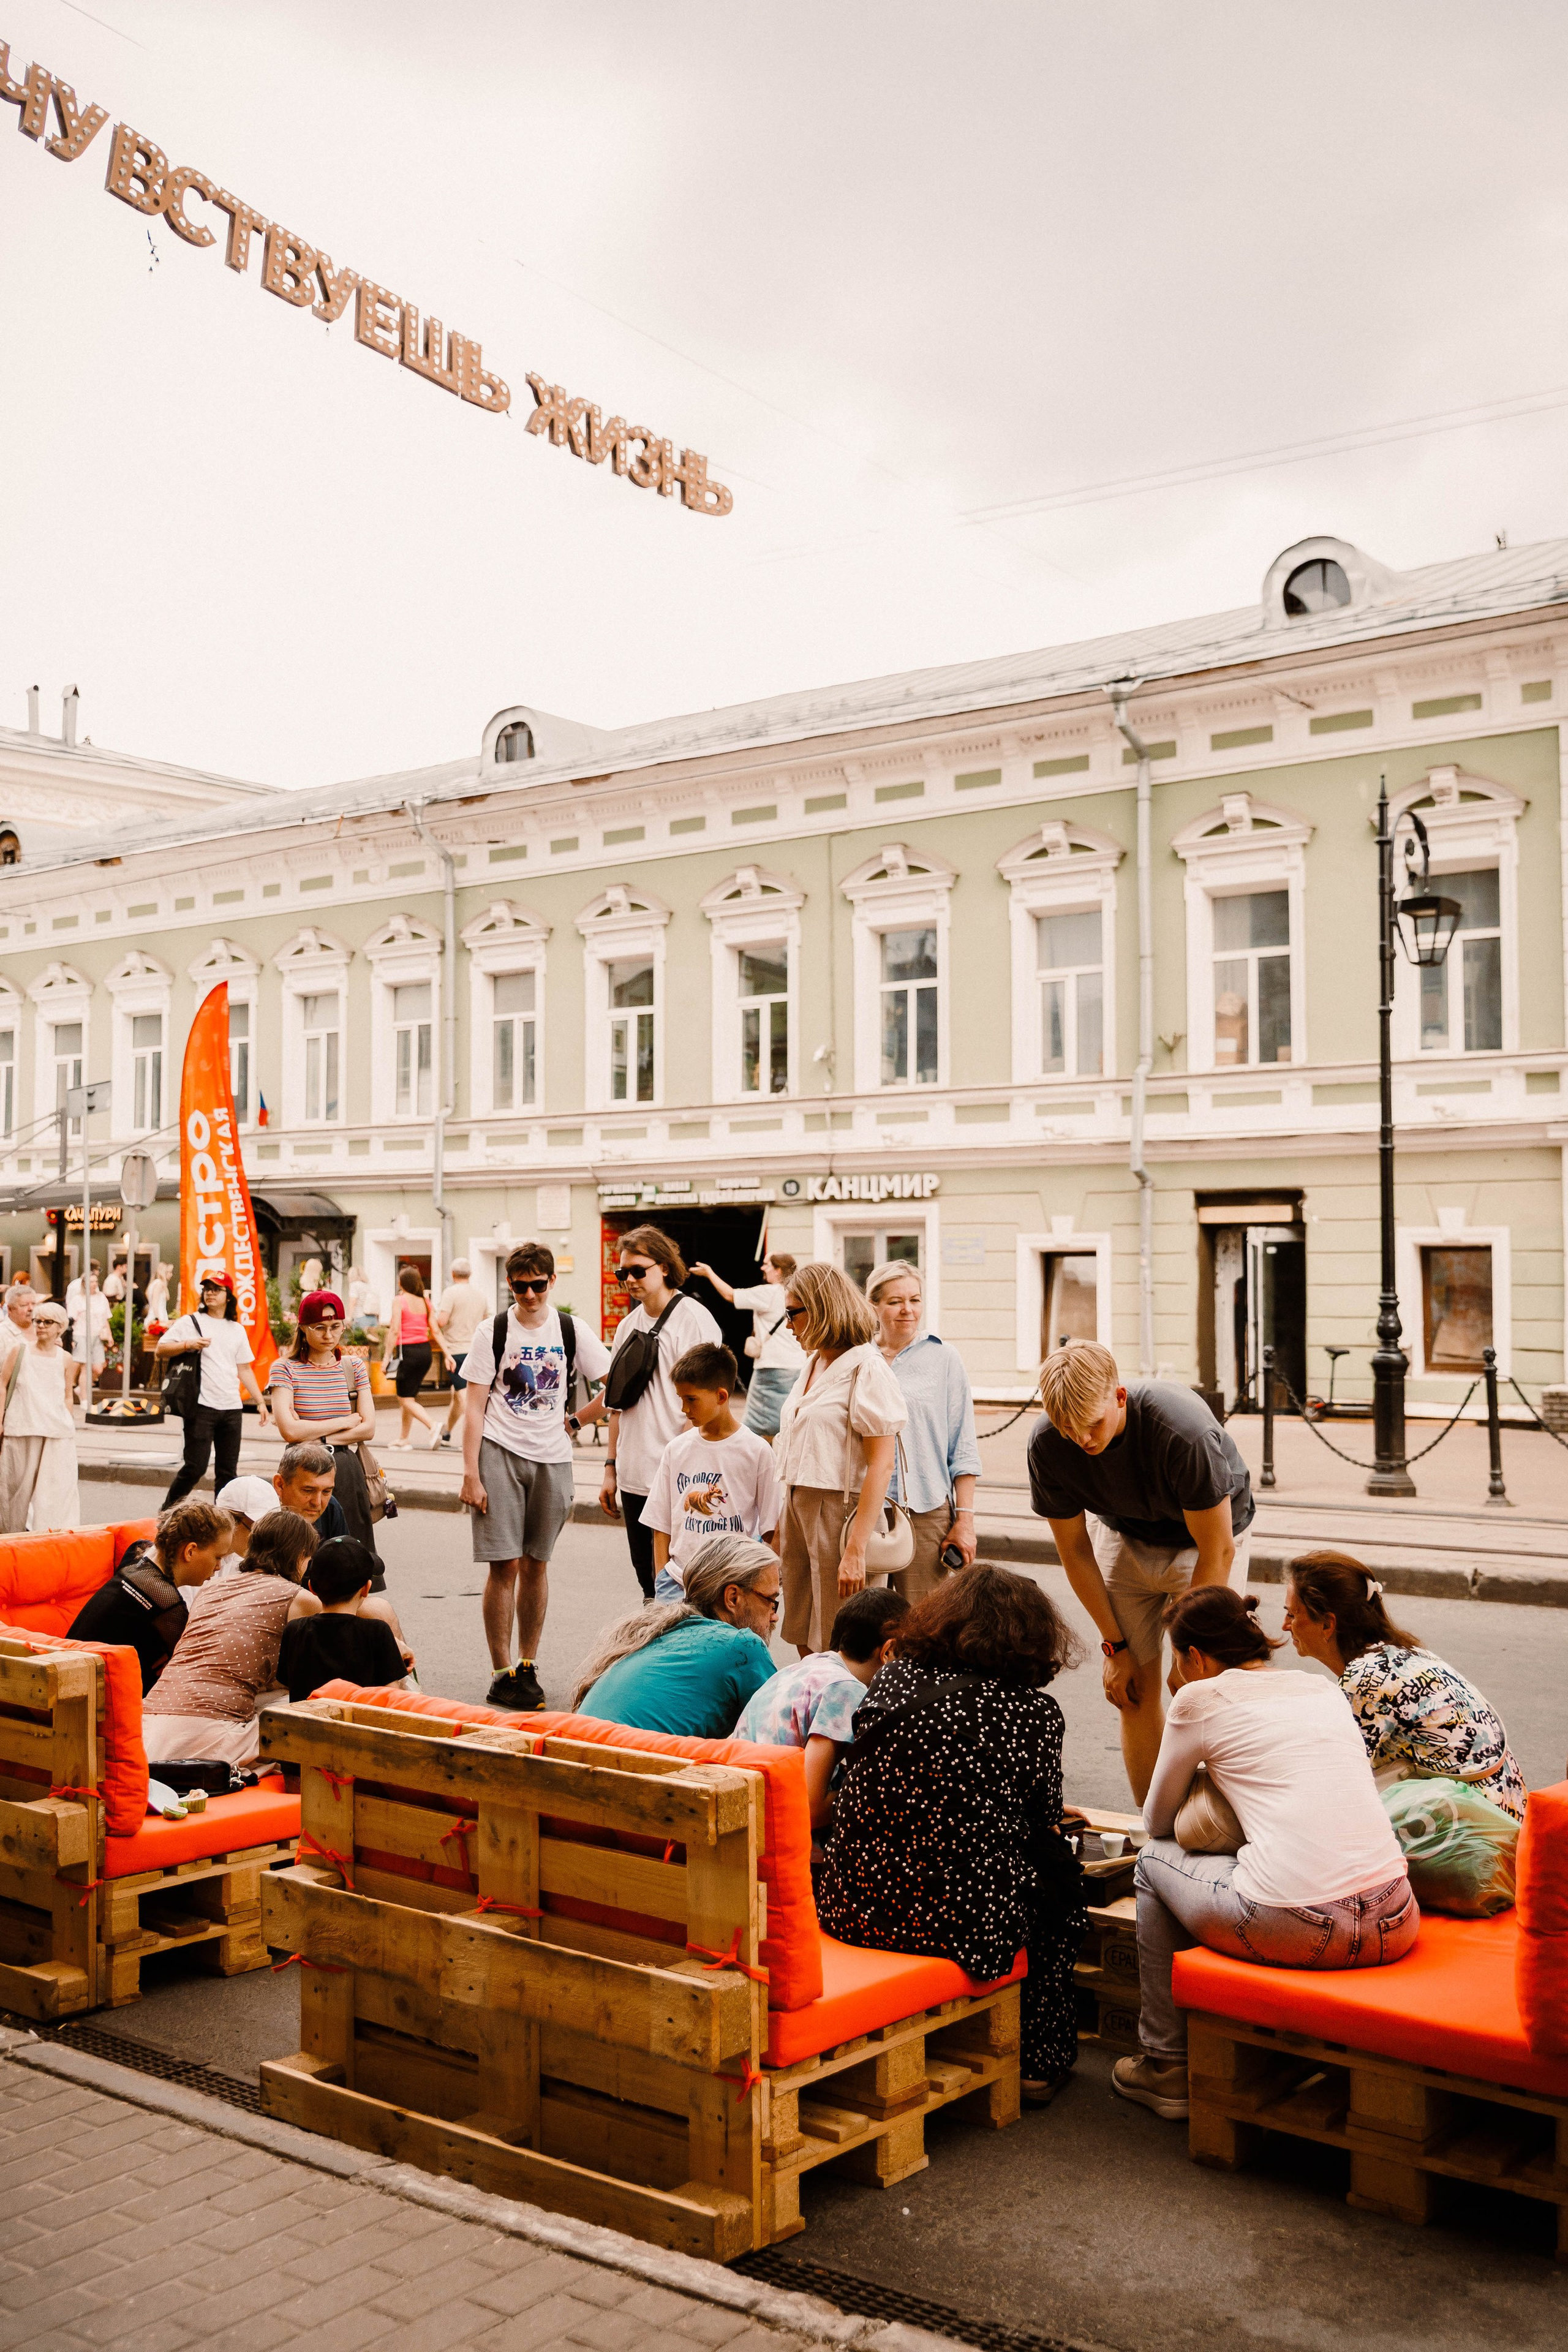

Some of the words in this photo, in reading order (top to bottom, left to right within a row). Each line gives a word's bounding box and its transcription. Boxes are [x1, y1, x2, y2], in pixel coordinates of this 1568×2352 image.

[524, 370, 733, 516] ЖИЗНЬ
[213, 1107, 256, 1327] РОЖДЕСТВЕНСКАЯ
[806, 1172, 941, 1202] КАНЦМИР
[701, 1517, 728, 1534] JUDGE
[729, 1514, 744, 1532] YOU
